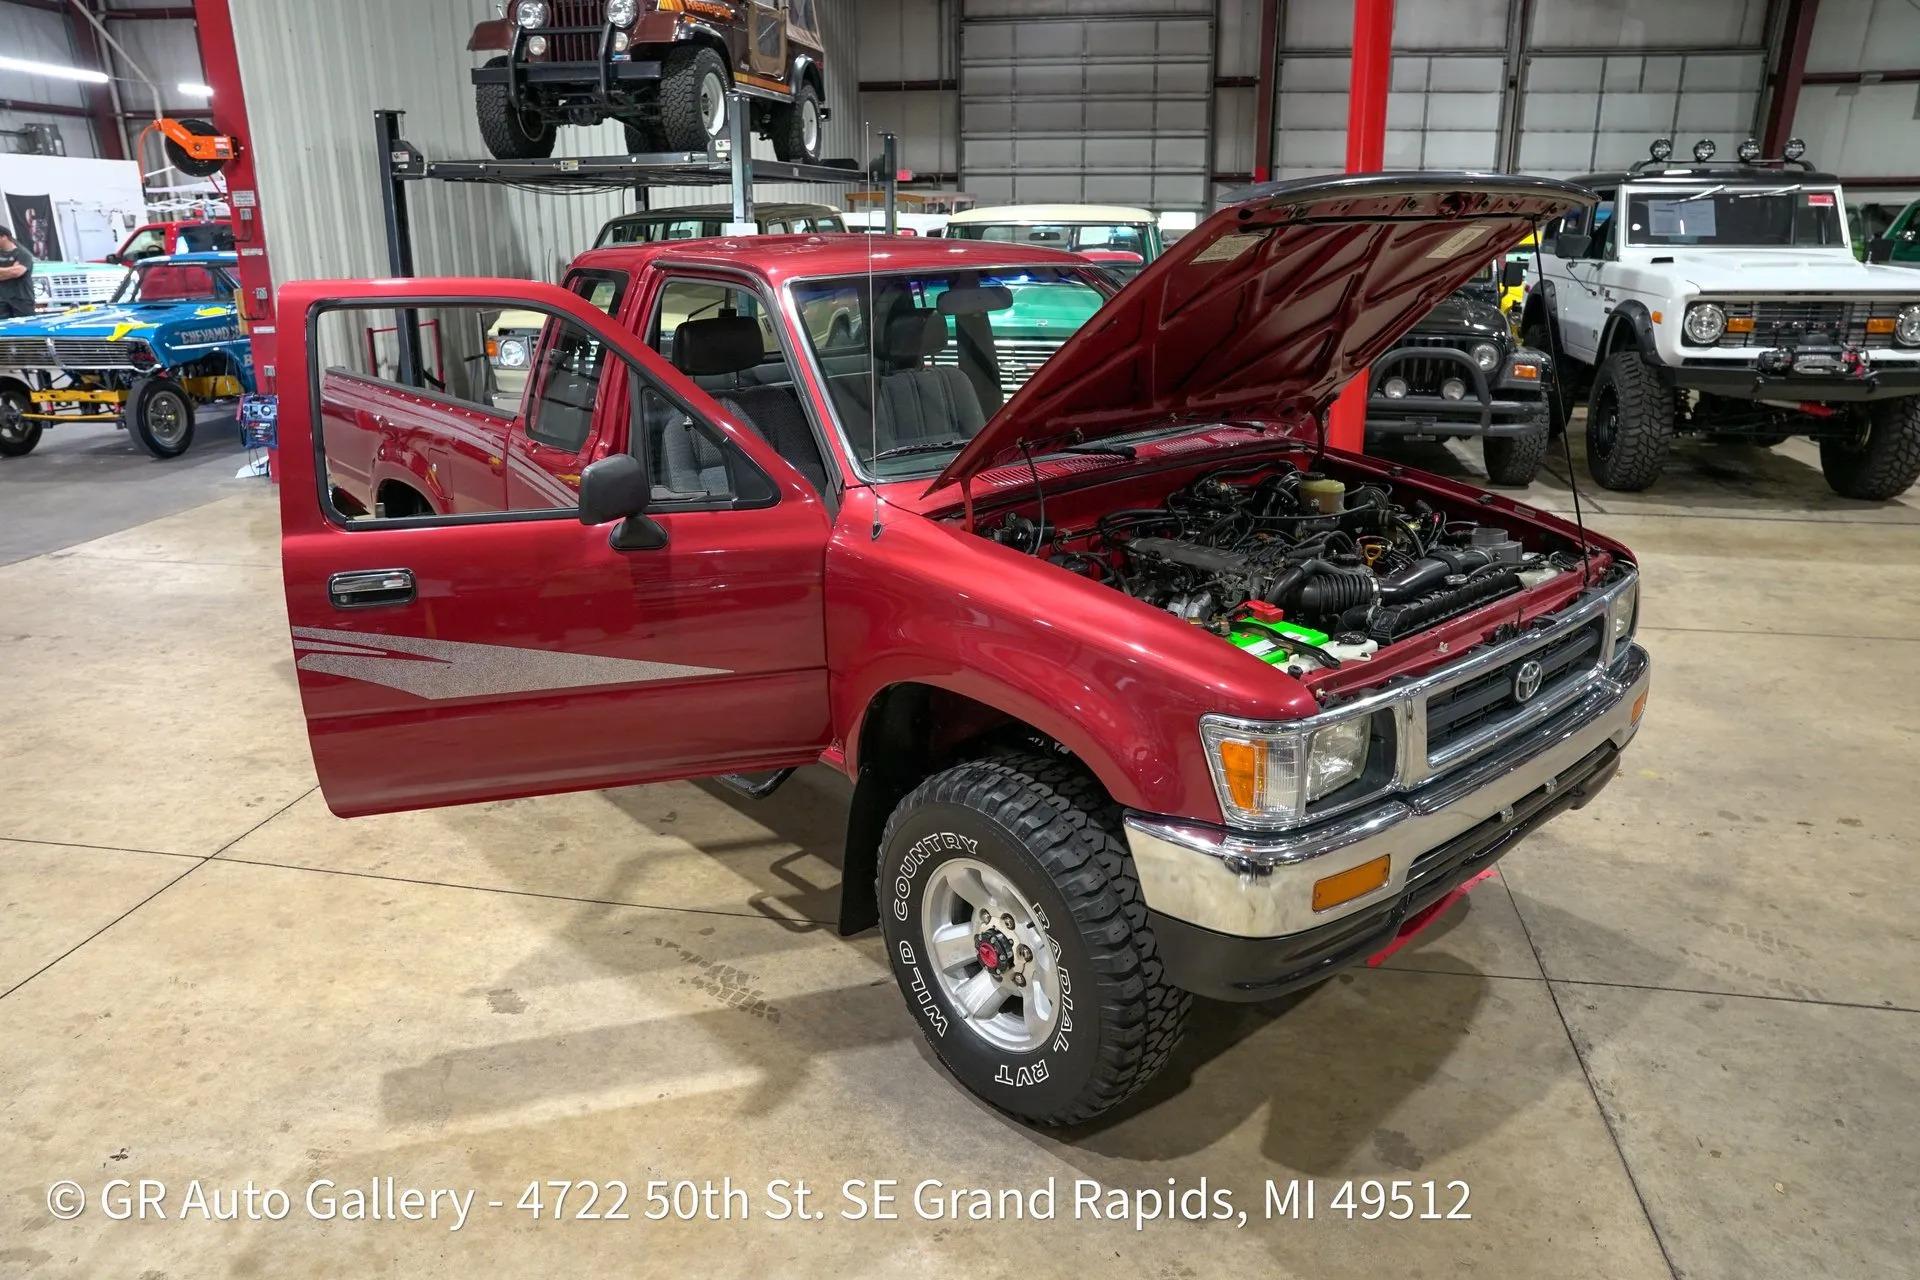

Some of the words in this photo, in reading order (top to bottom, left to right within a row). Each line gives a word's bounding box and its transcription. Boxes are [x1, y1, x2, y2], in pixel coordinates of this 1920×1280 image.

[894, 832, 979, 921] COUNTRY
[899, 940, 949, 1038] WILD
[1032, 902, 1074, 1052] RADIAL
[995, 1060, 1049, 1086] RVT
